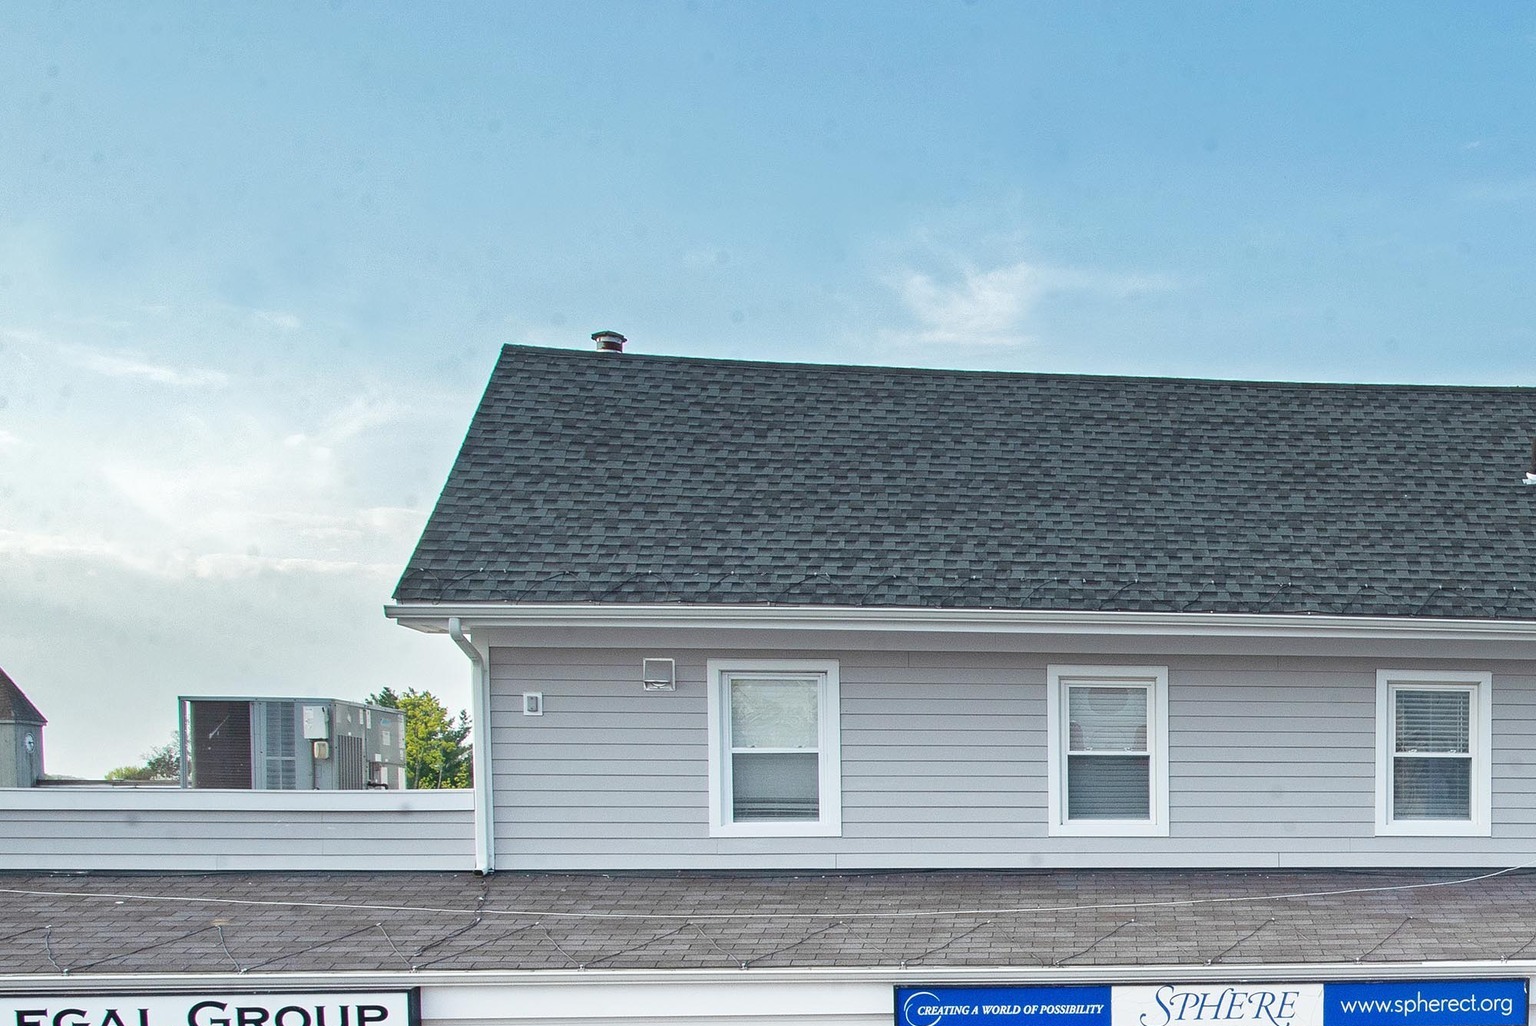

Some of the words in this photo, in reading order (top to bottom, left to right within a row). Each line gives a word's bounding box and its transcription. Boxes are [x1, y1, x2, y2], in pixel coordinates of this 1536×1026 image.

[917, 1005, 970, 1016] CREATING
[971, 1005, 979, 1015] A
[982, 1005, 1021, 1015] WORLD
[1023, 1004, 1040, 1015] OF
[1040, 1004, 1104, 1015] POSSIBILITY
[1340, 991, 1513, 1017] www.spherect.org
